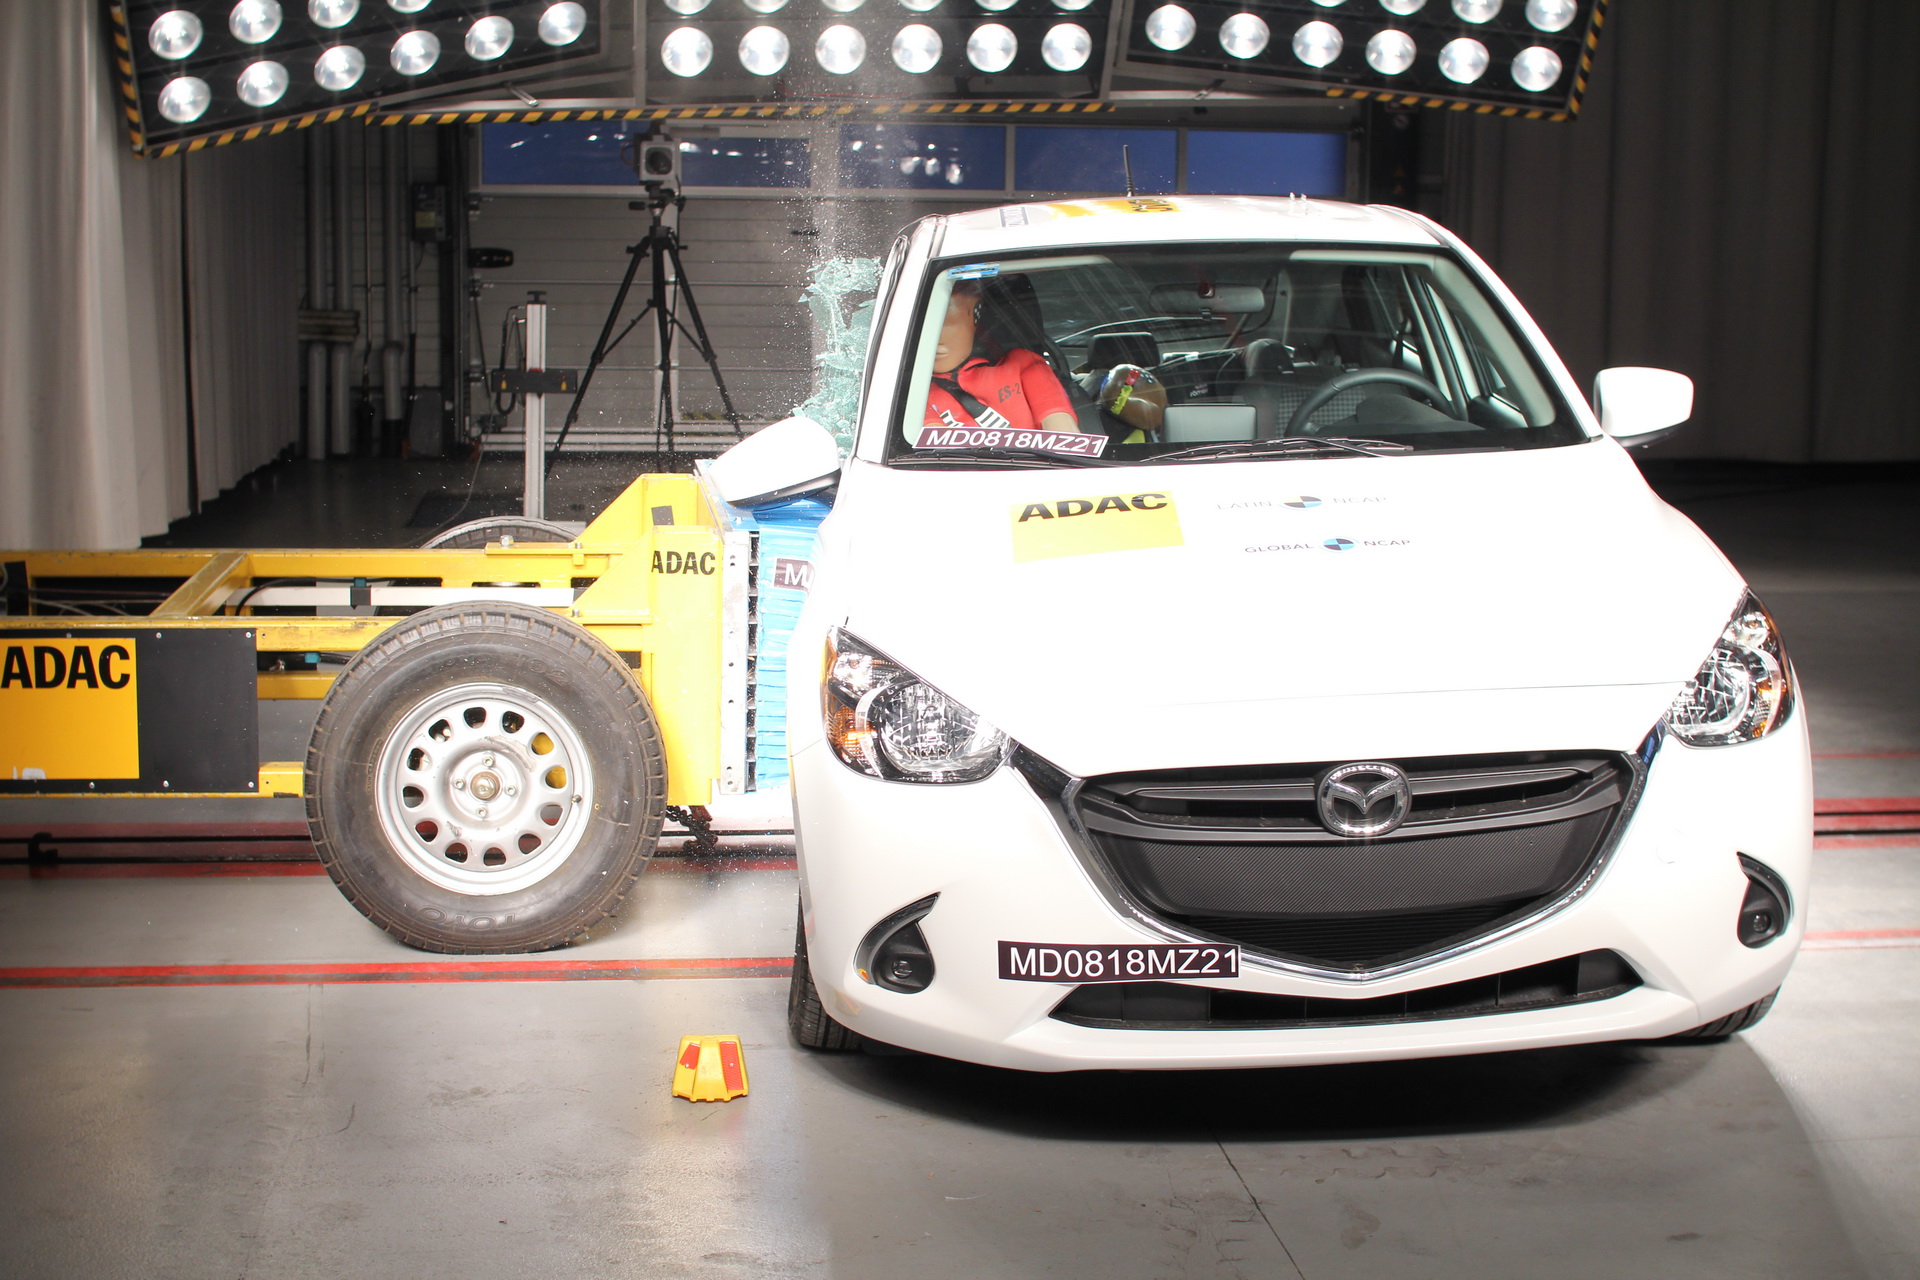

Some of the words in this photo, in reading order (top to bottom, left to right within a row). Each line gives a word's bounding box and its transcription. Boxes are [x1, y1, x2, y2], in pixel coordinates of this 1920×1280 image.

[998, 383, 1022, 403] ES-2
[926, 430, 1104, 454] MD0818MZ21
[1018, 493, 1168, 522] ADAC
[1244, 543, 1314, 553] GLOBAL
[1363, 539, 1411, 547] NCAP
[651, 550, 716, 576] ADAC
[1, 645, 131, 690] ADAC
[1010, 947, 1237, 977] MD0818MZ21
